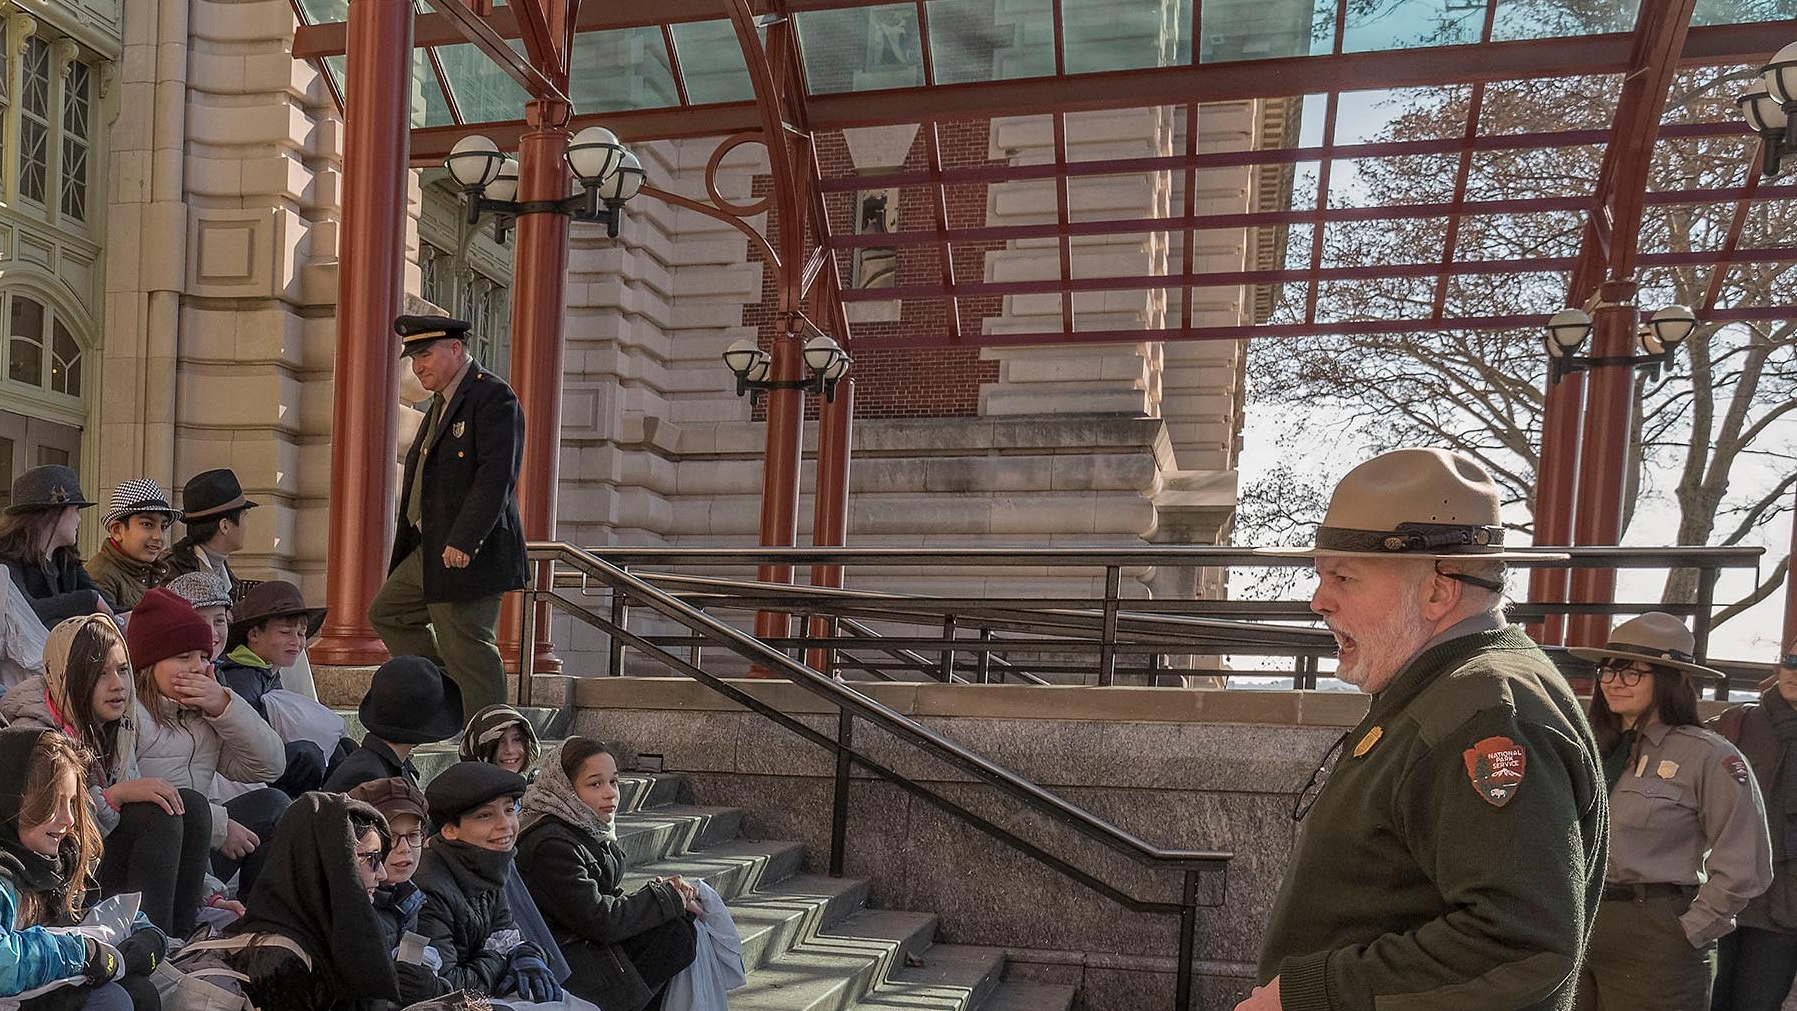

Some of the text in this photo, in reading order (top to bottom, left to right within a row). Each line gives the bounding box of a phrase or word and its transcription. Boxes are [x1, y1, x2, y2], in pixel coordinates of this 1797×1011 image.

[1488, 750, 1522, 760] NATIONAL
[1496, 755, 1513, 763] PARK
[1492, 760, 1519, 769] SERVICE
